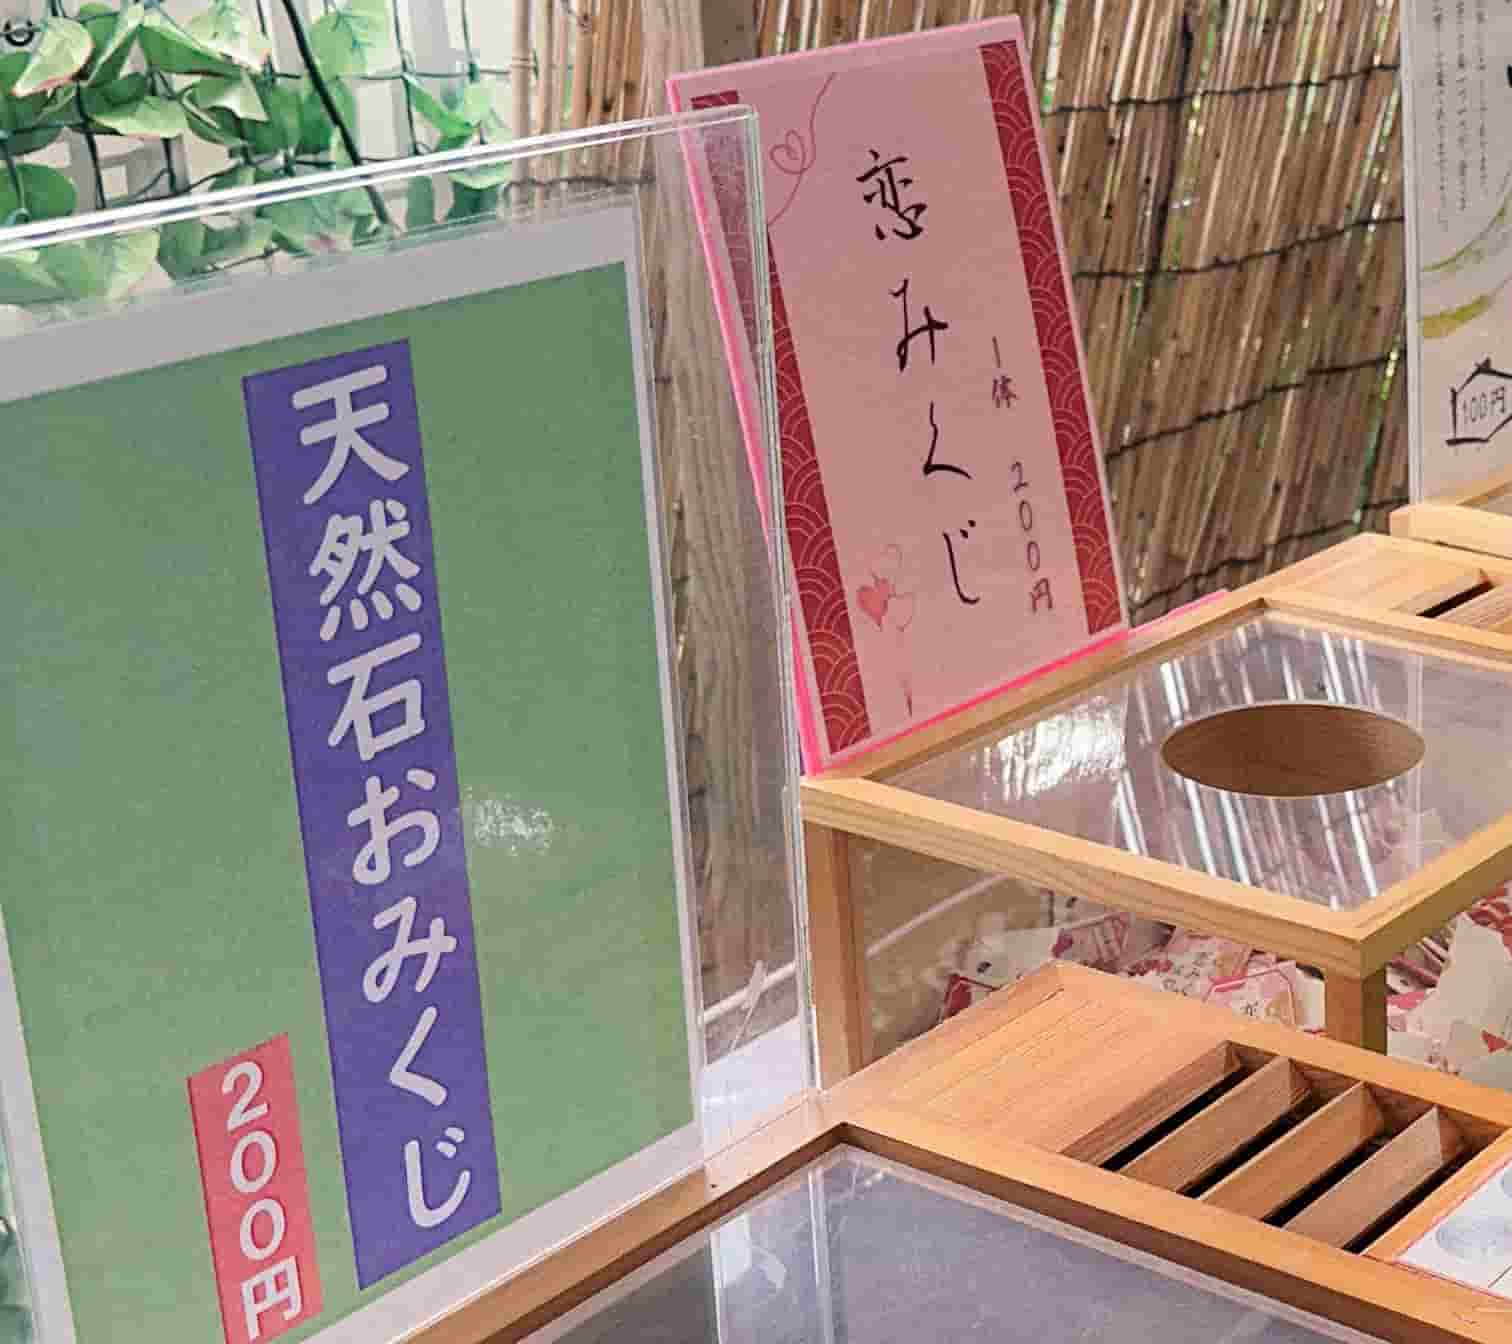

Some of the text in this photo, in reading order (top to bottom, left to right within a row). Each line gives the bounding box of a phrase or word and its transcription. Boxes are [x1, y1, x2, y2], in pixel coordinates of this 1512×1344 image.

[855, 149, 981, 606] 恋みくじ
[1009, 461, 1055, 614] 200円
[290, 362, 471, 1233] 天然石おみくじ
[219, 1058, 303, 1343] 200円
